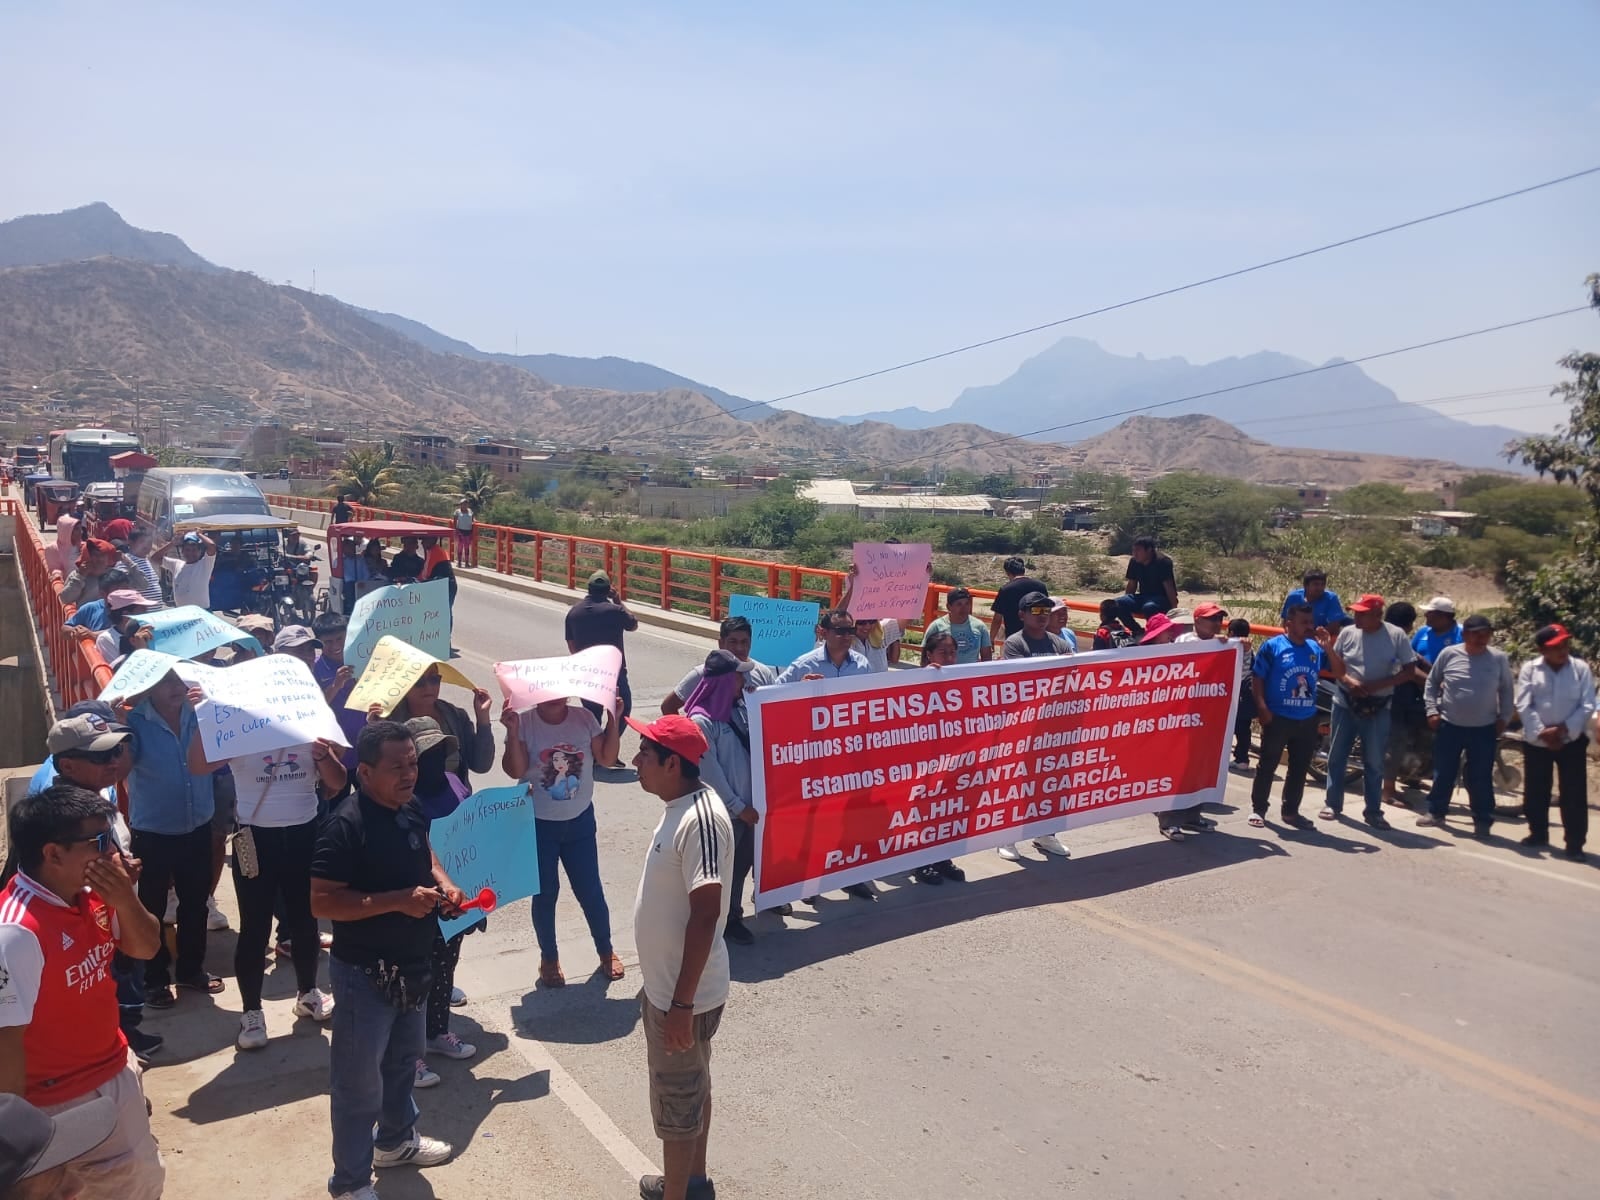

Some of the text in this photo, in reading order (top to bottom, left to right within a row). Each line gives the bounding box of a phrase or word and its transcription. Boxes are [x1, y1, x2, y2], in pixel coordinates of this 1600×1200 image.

[359, 592, 421, 617] ESTAMOS EN
[365, 616, 413, 636] PELIGRO
[757, 628, 792, 640] AHORA
[811, 661, 1201, 731] DEFENSAS RIBEREÑAS AHORA.
[215, 730, 236, 748] POR
[241, 717, 272, 734] CULPA
[771, 735, 842, 766] Exigimos
[844, 734, 864, 753] se
[866, 722, 937, 750] reanuden
[939, 718, 962, 739] los
[965, 710, 1019, 735] trabajos
[1020, 706, 1036, 723] de
[1037, 698, 1092, 721] defensas
[1092, 689, 1150, 711] ribereñas
[1152, 685, 1170, 704] del
[1188, 681, 1228, 698] olmos.
[801, 712, 1204, 800] Estamos en peligro ante el abandono de las obras.
[256, 771, 307, 783] UNDER ARMOUR
[908, 747, 1117, 801] P.J. SANTA ISABEL.
[474, 795, 527, 820] RESPUESTA
[888, 763, 1128, 829] AA.HH. ALAN GARCÍA.
[824, 776, 1173, 869] P.J. VIRGEN DE LAS MERCEDES
[443, 845, 477, 875] PARO
[79, 973, 96, 995] FLY
